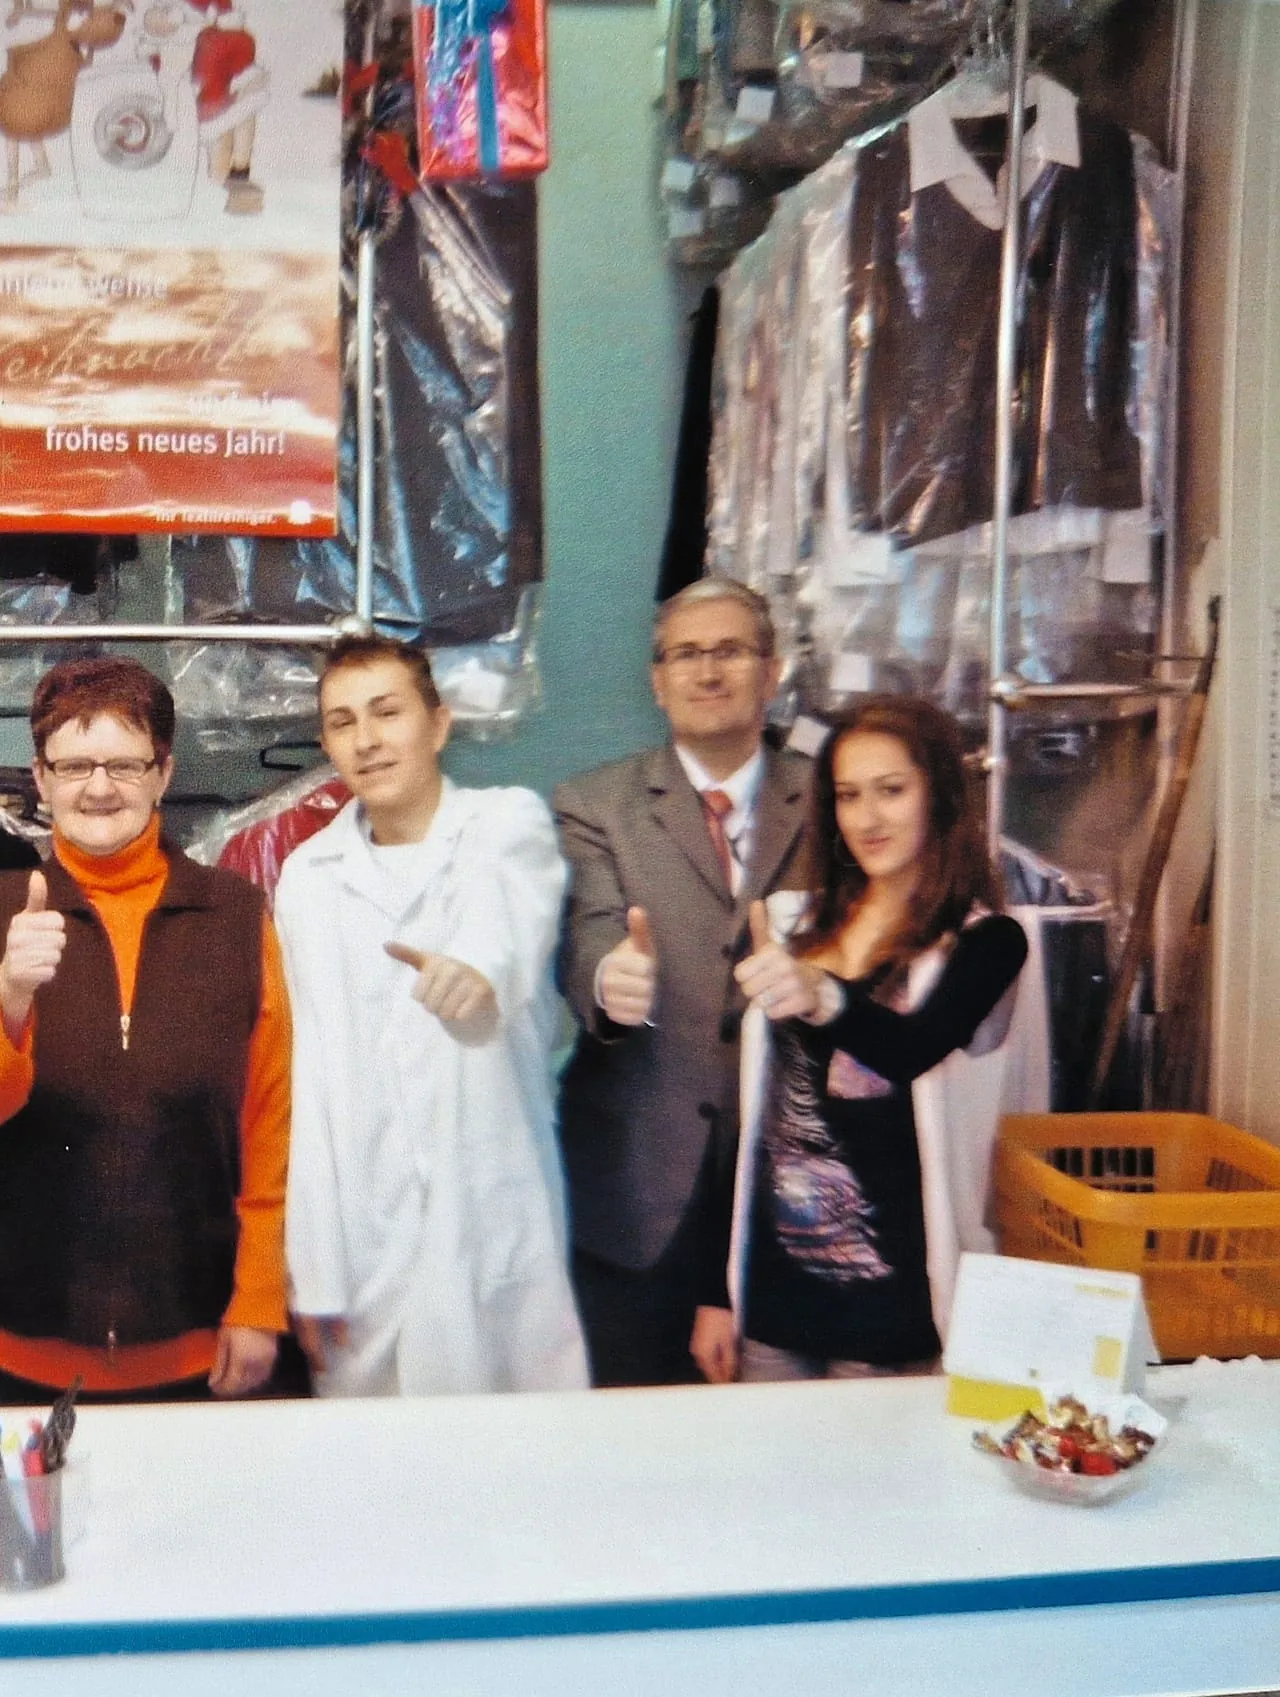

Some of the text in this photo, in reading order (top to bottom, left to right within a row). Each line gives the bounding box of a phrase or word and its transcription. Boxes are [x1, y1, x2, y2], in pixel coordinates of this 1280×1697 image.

[44, 425, 286, 458] frohes neues Jahr!
